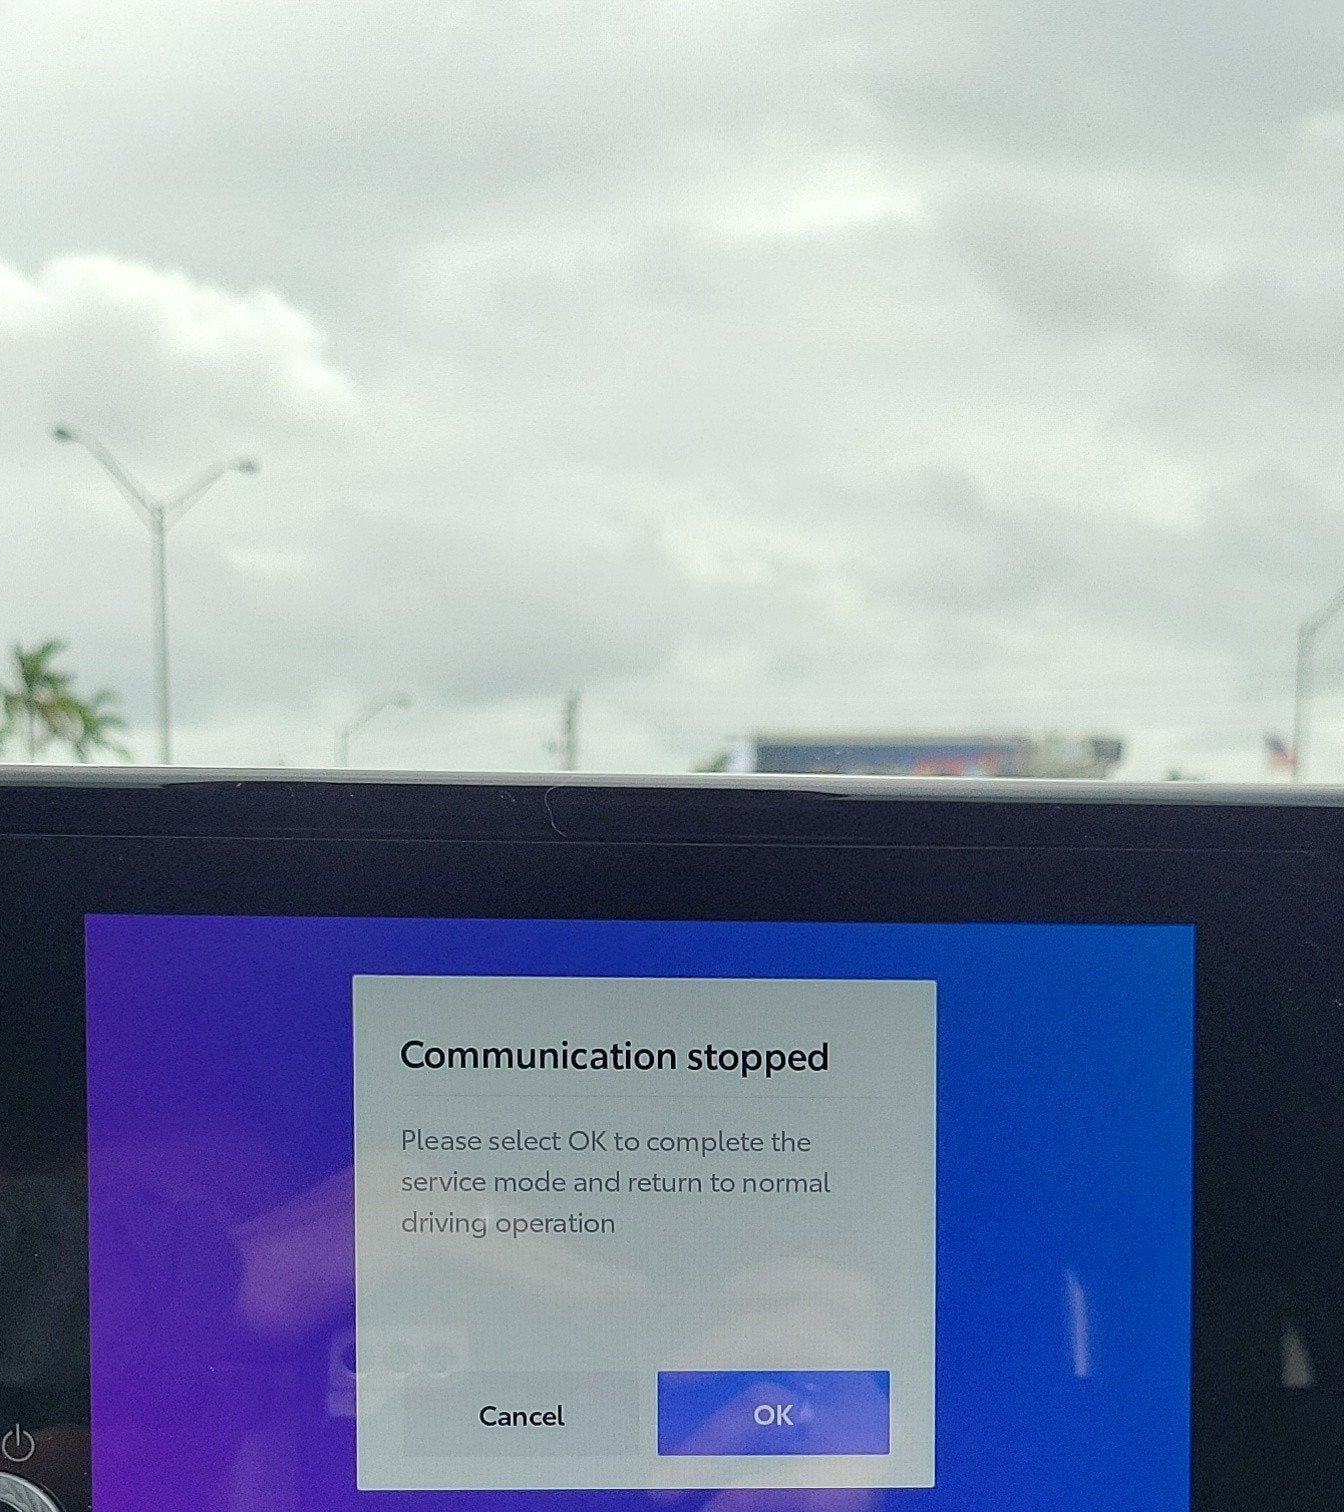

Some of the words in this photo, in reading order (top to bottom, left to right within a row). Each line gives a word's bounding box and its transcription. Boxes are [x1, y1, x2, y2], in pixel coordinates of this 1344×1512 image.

[401, 1041, 677, 1071] Communication
[687, 1042, 830, 1078] stopped
[401, 1129, 482, 1152] Please
[488, 1131, 561, 1153] select
[568, 1131, 608, 1153] OK
[614, 1133, 640, 1153] to
[647, 1131, 764, 1159] complete
[771, 1131, 811, 1154] the
[401, 1173, 486, 1193] service
[494, 1171, 566, 1193] mode
[573, 1171, 621, 1194] and
[628, 1174, 702, 1194] return
[710, 1174, 735, 1194] to
[742, 1172, 831, 1195] normal
[401, 1211, 487, 1239] driving
[495, 1213, 615, 1239] operation
[479, 1405, 565, 1428] Cancel
[754, 1405, 794, 1427] OK
